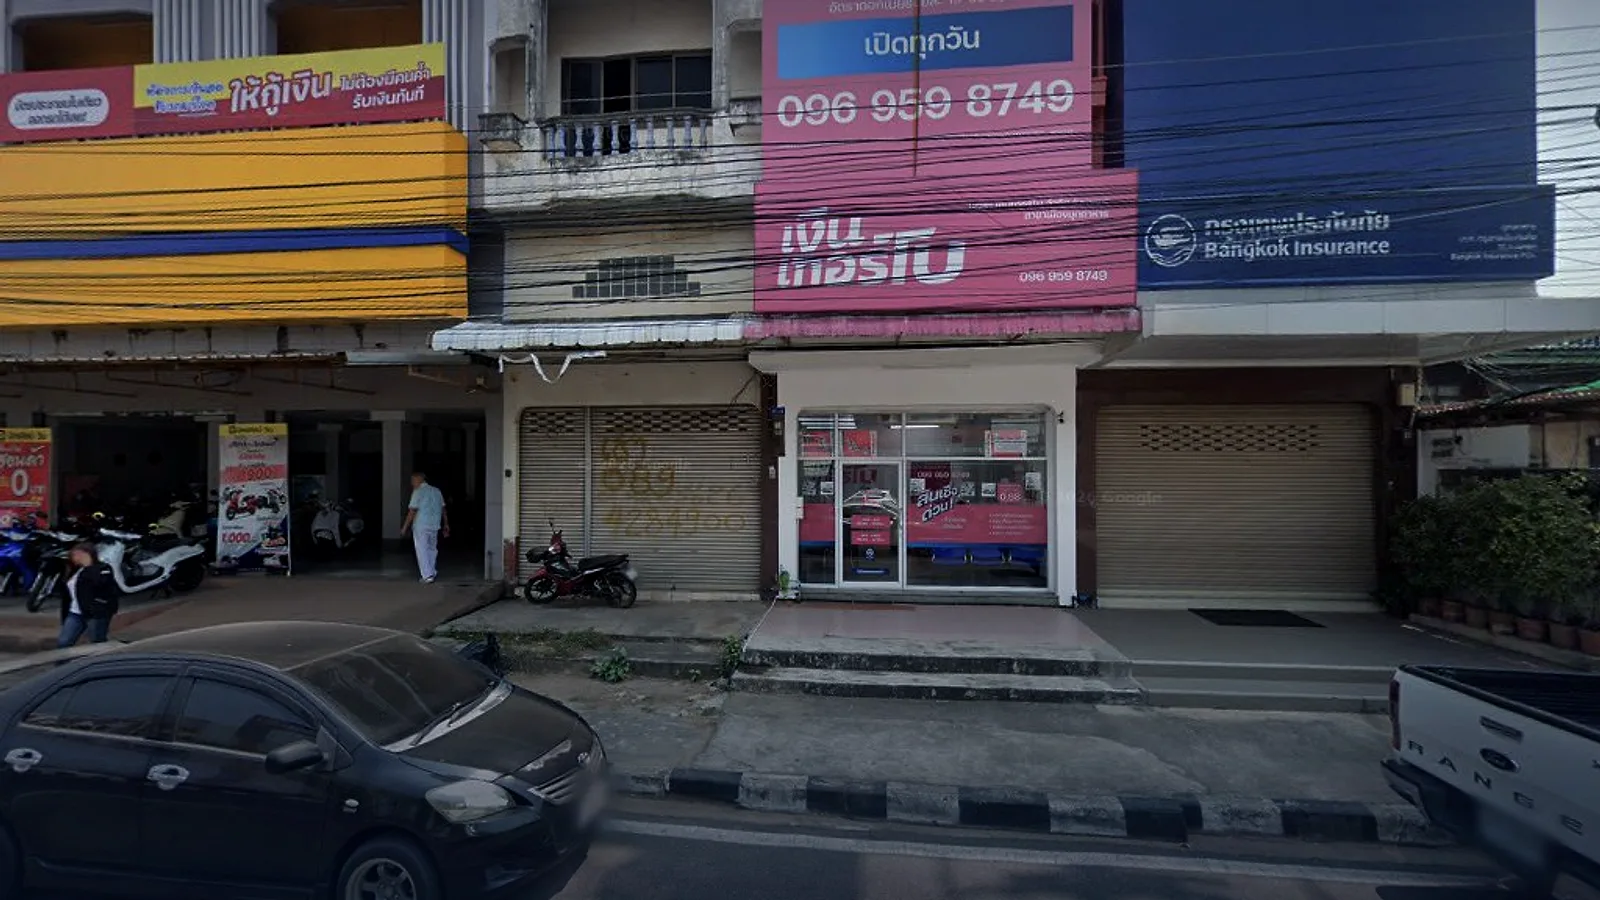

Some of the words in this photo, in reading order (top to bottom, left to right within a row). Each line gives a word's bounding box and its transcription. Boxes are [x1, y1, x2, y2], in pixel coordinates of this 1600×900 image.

[865, 26, 980, 59] เปิดทุกวัน
[340, 61, 431, 91] ไม่ต้องมีคนค้ำ
[229, 69, 333, 115] ให้กู้เงิน
[352, 85, 426, 109] รับเงินทันที
[777, 91, 857, 127] 096
[870, 86, 952, 122] 959
[966, 79, 1075, 117] 8749
[1204, 239, 1290, 261] Bangkok
[1295, 238, 1390, 257] Insurance
[1019, 271, 1044, 283] 096
[1047, 271, 1072, 282] 959
[1076, 270, 1108, 281] 8749
